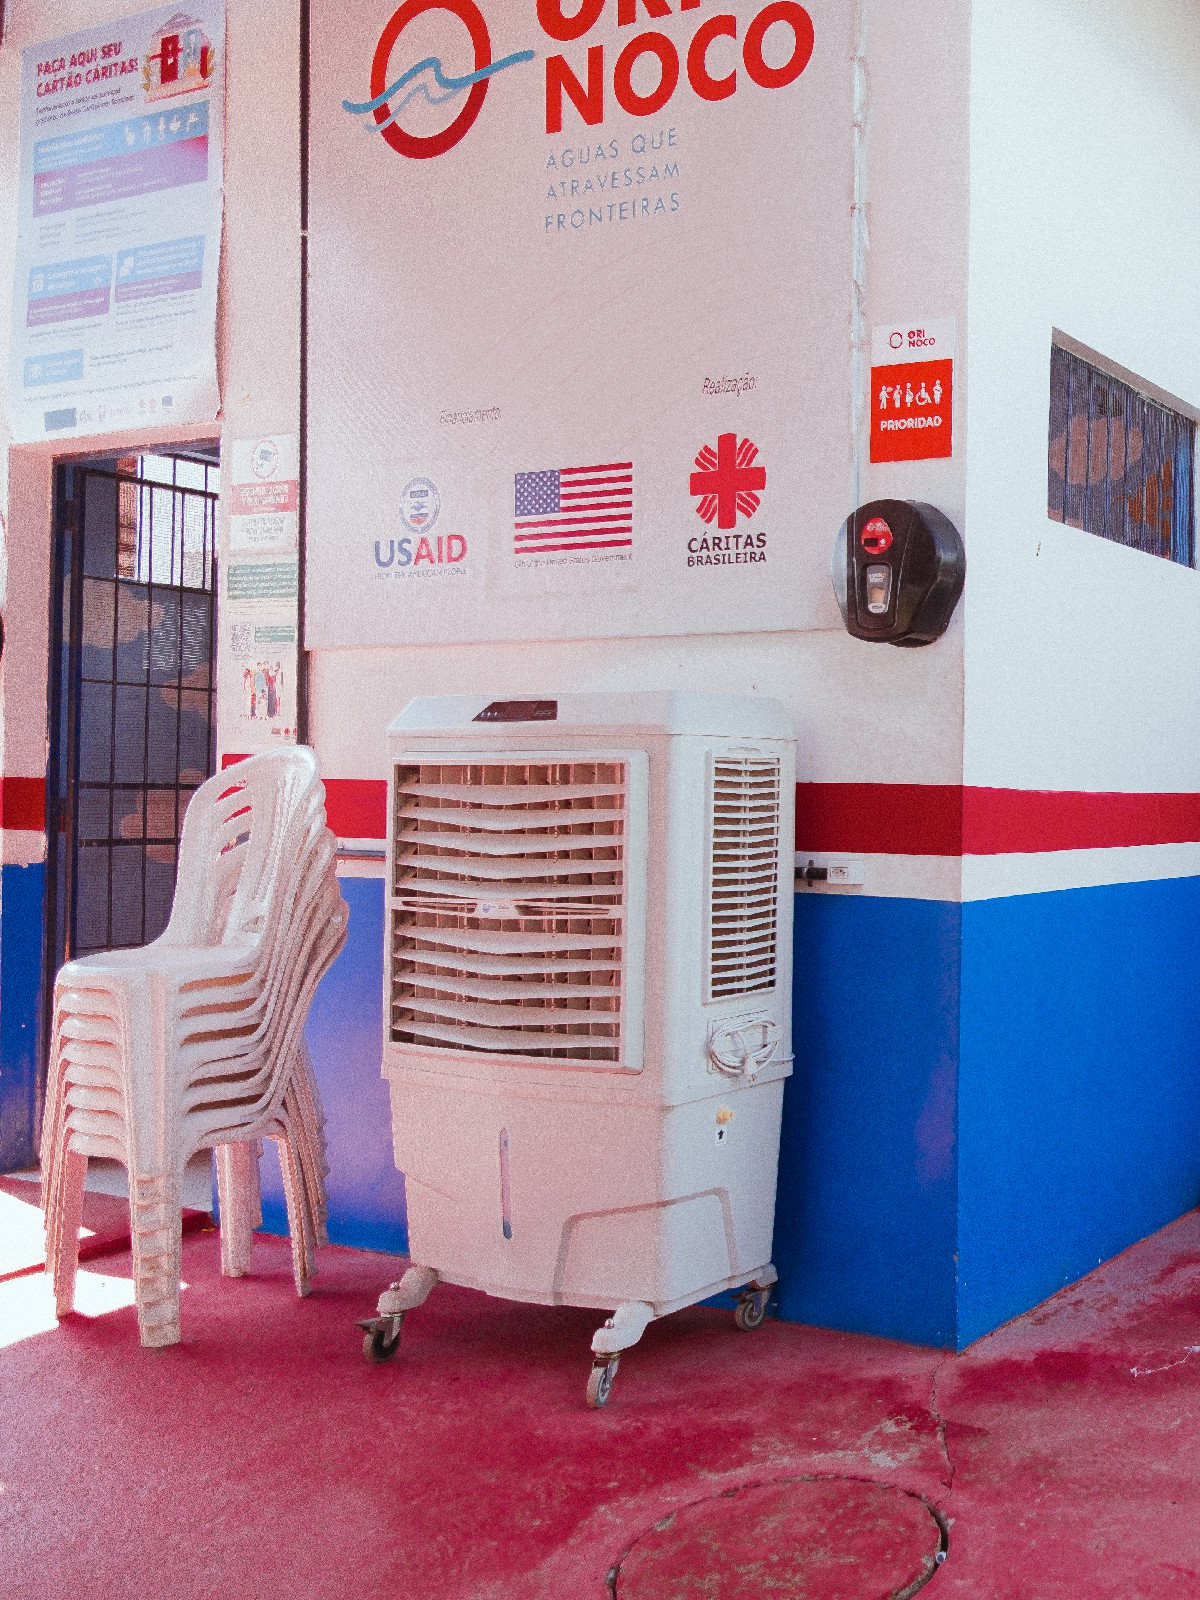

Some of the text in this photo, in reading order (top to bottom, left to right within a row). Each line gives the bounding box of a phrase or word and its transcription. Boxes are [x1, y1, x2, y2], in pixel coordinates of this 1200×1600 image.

[69, 48, 97, 68] AQUI
[101, 41, 123, 60] SEU
[546, 1, 815, 134] NOCO
[37, 71, 82, 97] CARTÃO
[631, 128, 677, 153] QUE
[546, 162, 679, 200] ATRAVESSAM
[545, 192, 680, 233] FRONTEIRAS
[908, 330, 925, 339] ORI
[908, 338, 936, 348] NOCO
[880, 415, 943, 431] PRIORIDAD
[374, 534, 468, 568] USAID
[687, 531, 767, 553] CÁRITAS
[687, 551, 767, 567] BRASILEIRA
